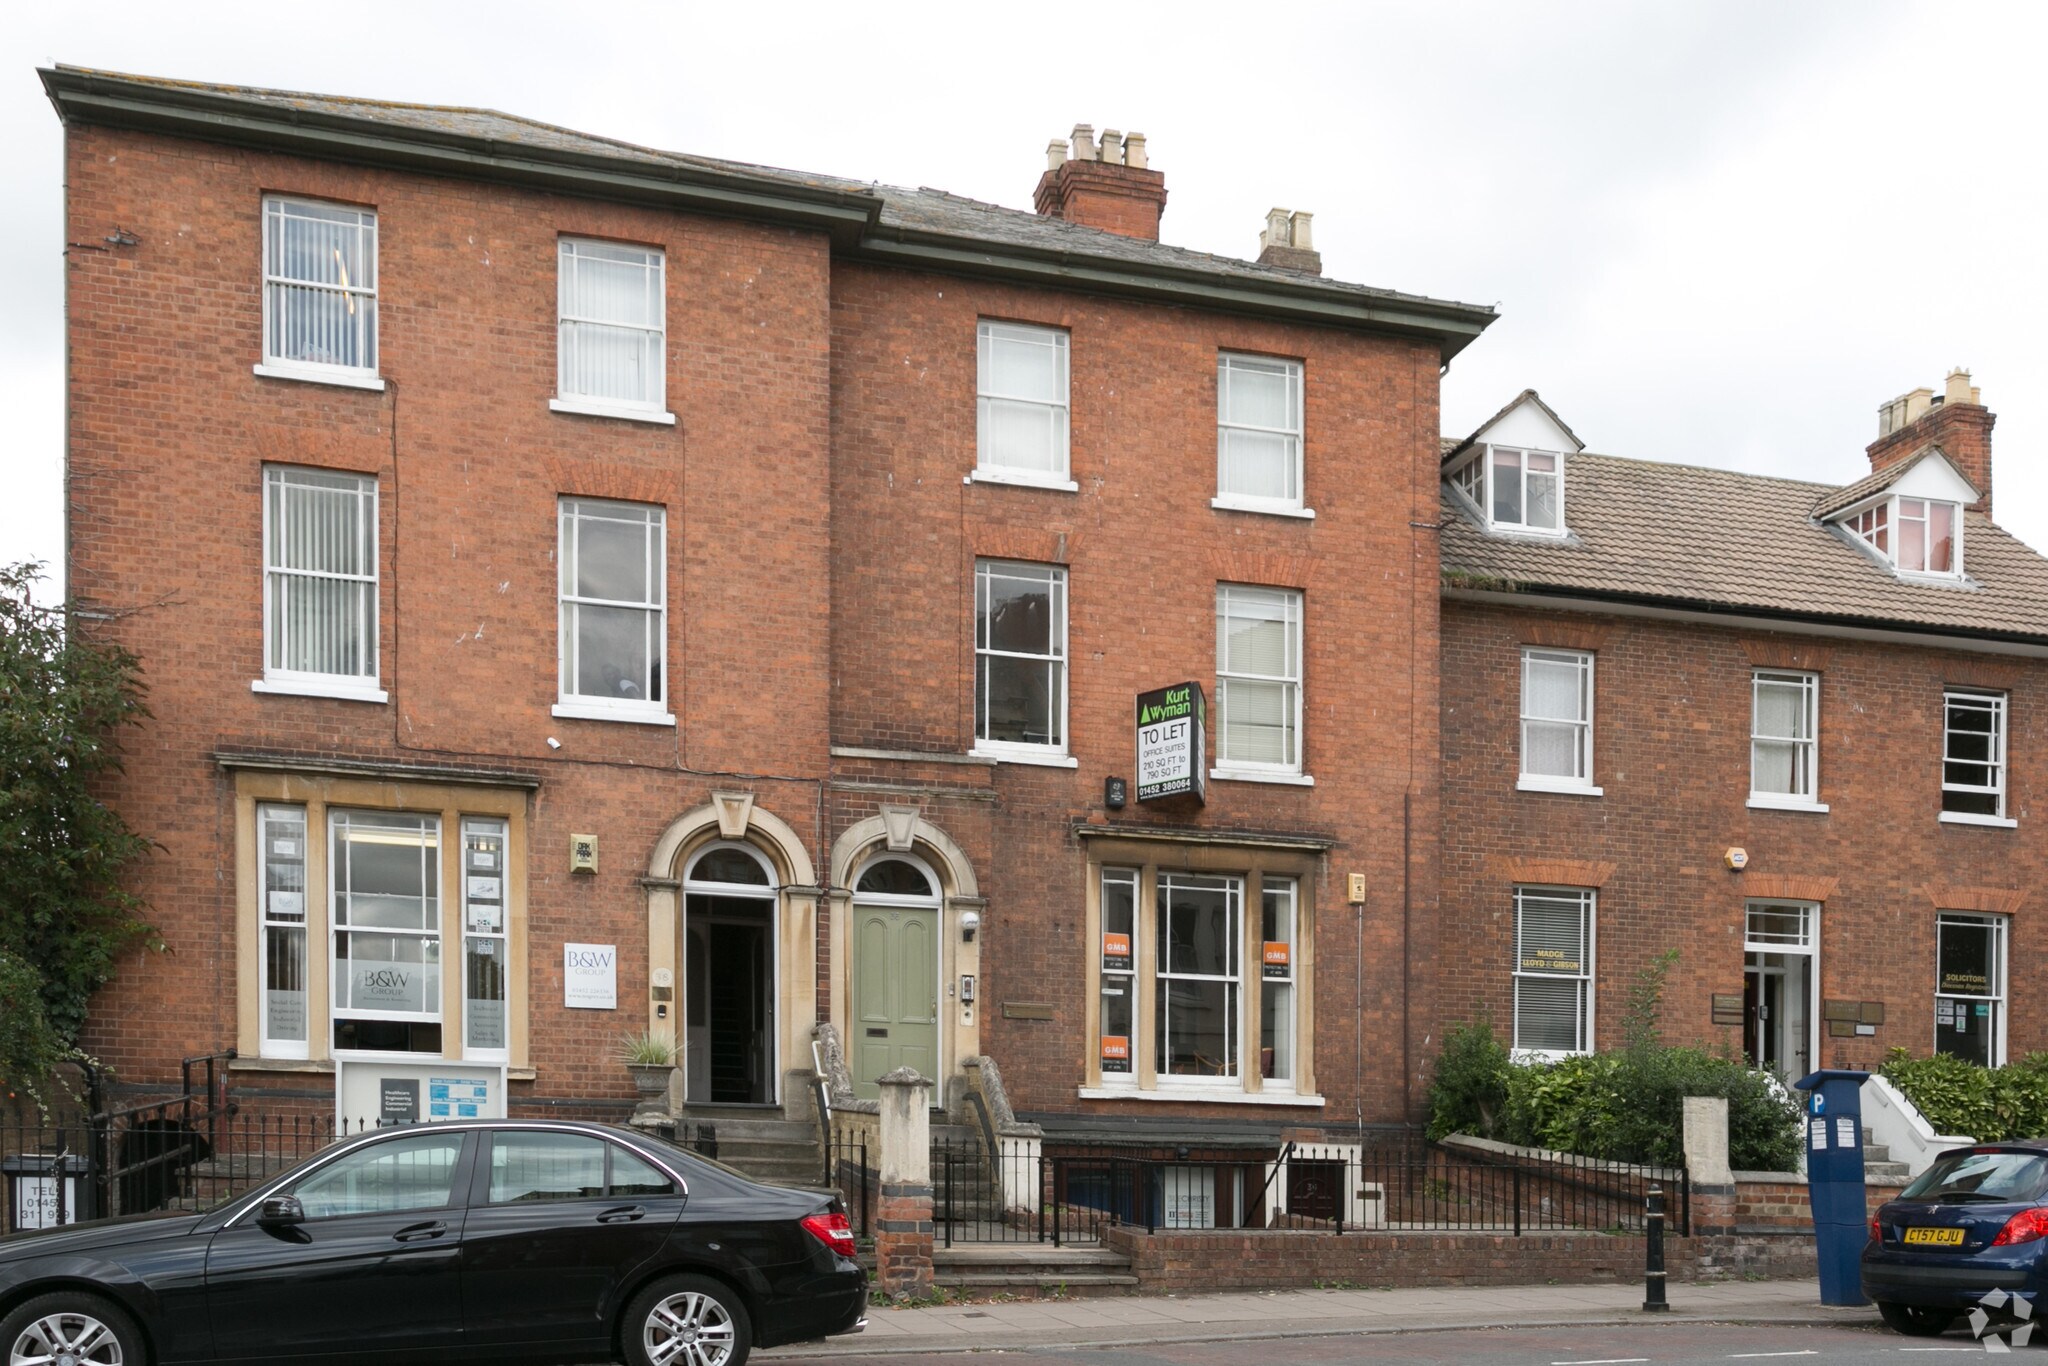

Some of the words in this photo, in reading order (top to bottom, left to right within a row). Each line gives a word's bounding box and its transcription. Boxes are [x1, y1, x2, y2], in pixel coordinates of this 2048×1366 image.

[1166, 687, 1190, 705] Kurt
[1149, 702, 1190, 721] Wyman
[1142, 728, 1159, 745] TO
[1163, 722, 1187, 741] LET
[1143, 747, 1163, 758] OFFICE
[1165, 742, 1186, 754] SUITES
[1143, 760, 1154, 770] 210
[1156, 757, 1166, 768] SQ
[1168, 755, 1177, 765] FT
[1179, 755, 1186, 763] to
[1147, 770, 1159, 780] 790
[1160, 767, 1171, 777] SQ
[1173, 765, 1182, 774] FT
[1139, 784, 1160, 796] 01452
[1162, 778, 1191, 791] 380064
[577, 842, 591, 850] OAK
[576, 849, 592, 858] PARK
[1106, 942, 1127, 952] GMB
[1536, 949, 1564, 958] MADGE
[568, 950, 612, 968] B&W
[1266, 950, 1287, 960] GMB
[1522, 959, 1545, 967] LLOYD
[1553, 960, 1579, 969] GIBSON
[575, 967, 606, 976] GROUP
[365, 969, 410, 988] B&W
[1946, 974, 1987, 983] SOLICITORS
[371, 987, 404, 996] GROUP
[1104, 1044, 1126, 1055] GMB
[1814, 1093, 1824, 1113] P
[1909, 1229, 1936, 1241] CT57
[1936, 1229, 1960, 1242] GJU
